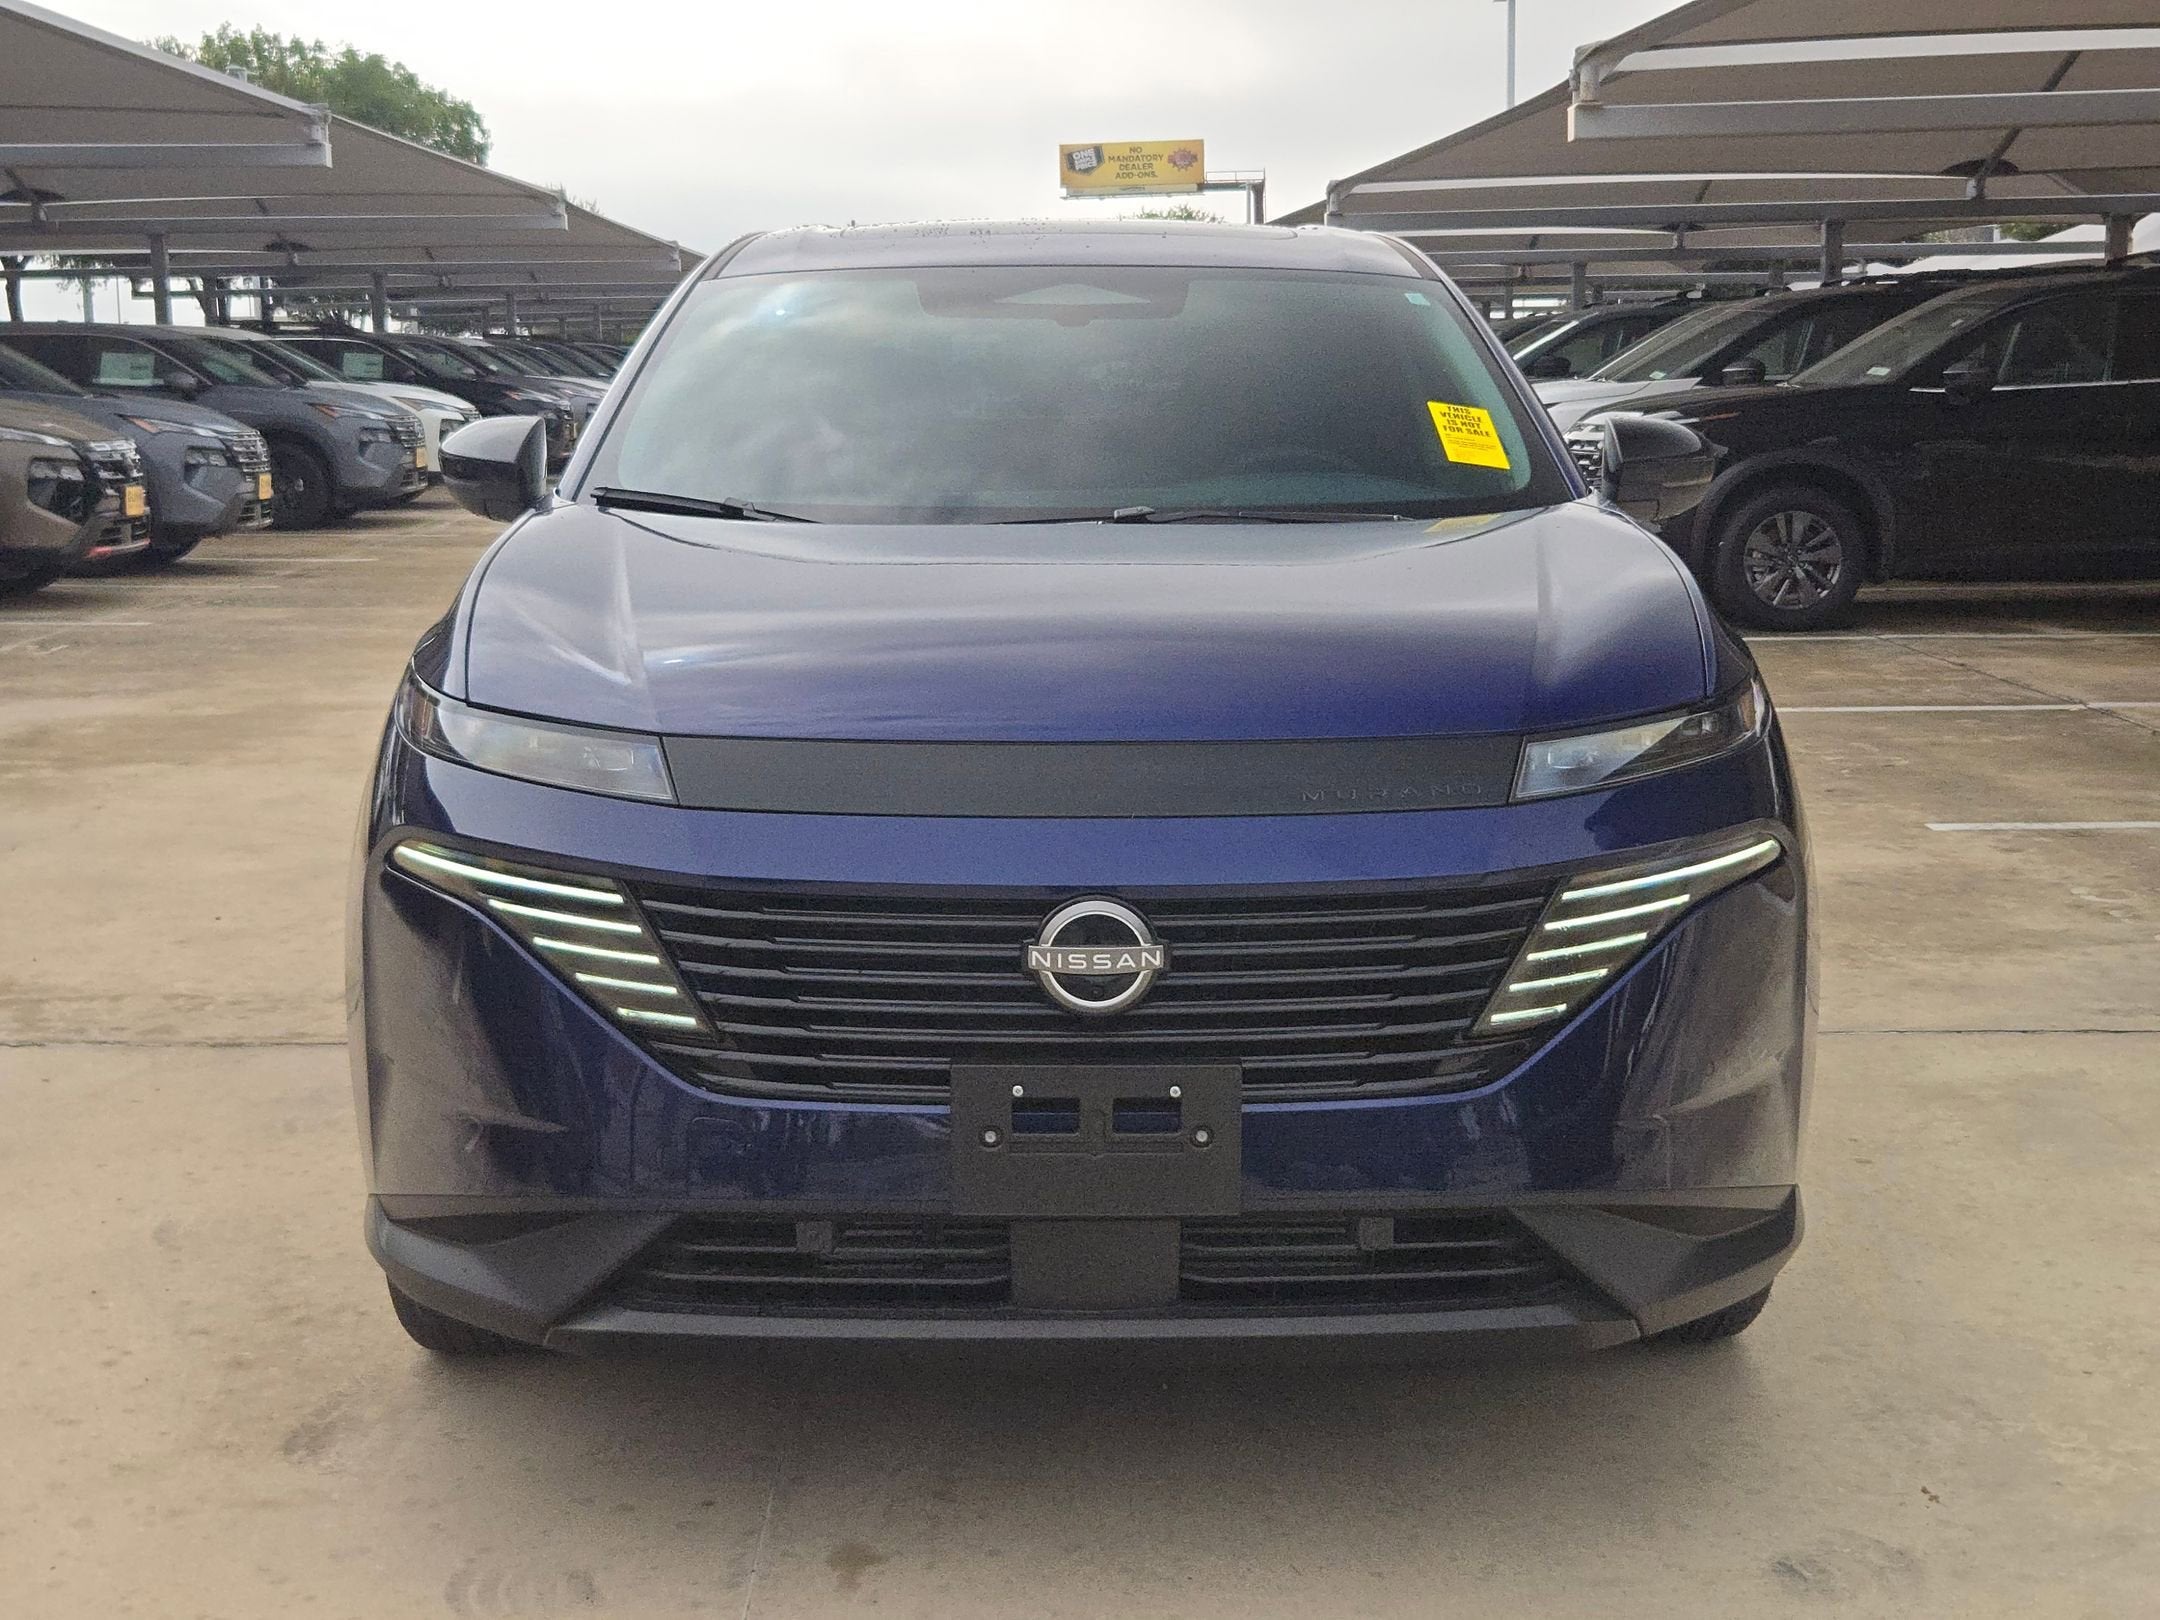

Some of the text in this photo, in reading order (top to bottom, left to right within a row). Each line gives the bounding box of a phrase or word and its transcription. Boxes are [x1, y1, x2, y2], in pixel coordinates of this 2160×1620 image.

[1108, 154, 1164, 162] MANDATORY
[1447, 406, 1471, 414] THIS
[1440, 411, 1481, 422] VEHICLE
[1460, 421, 1481, 429] NOT
[1443, 425, 1491, 437] FOR SALE
[1303, 783, 1481, 800] MURANO
[1031, 950, 1161, 969] NISSAN
